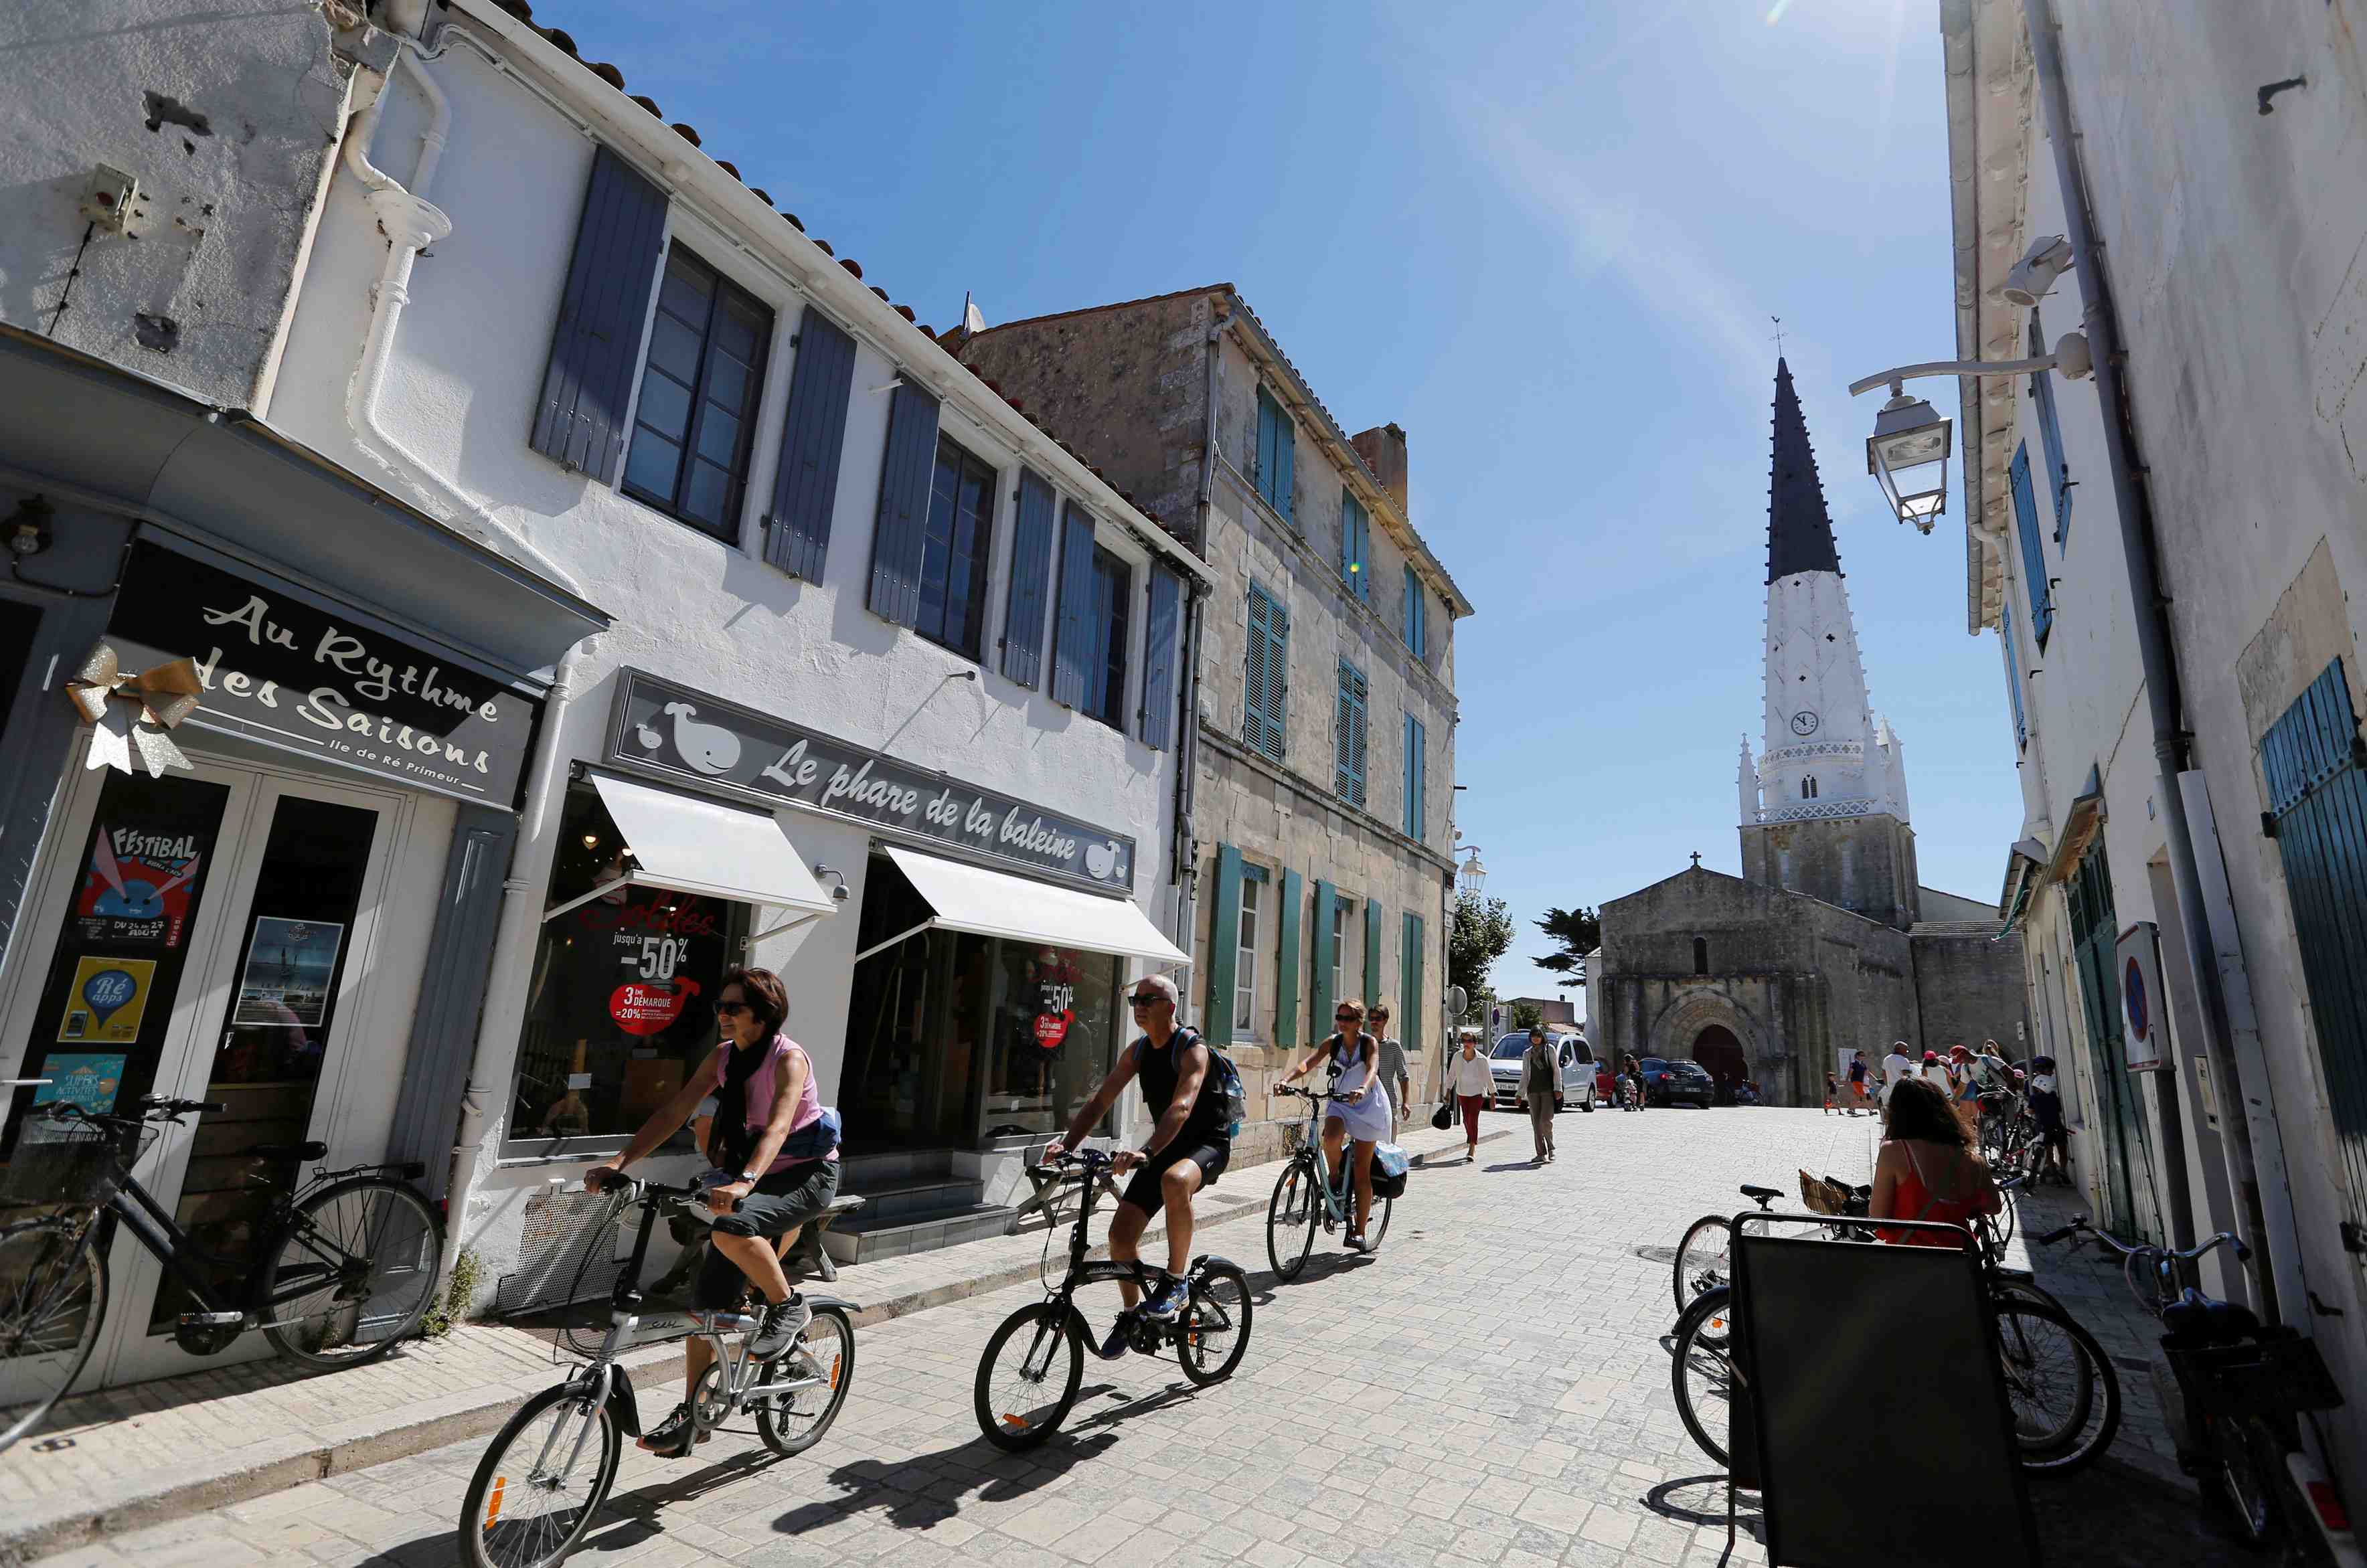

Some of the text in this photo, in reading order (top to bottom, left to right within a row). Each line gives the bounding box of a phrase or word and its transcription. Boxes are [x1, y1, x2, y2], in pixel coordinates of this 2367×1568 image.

[202, 595, 497, 723] Au Rythme
[296, 687, 489, 774] Saisons
[329, 739, 460, 784] Ile de Ré Primeur
[760, 739, 1076, 859] Le phare de la baleine
[621, 937, 688, 980] -50%
[92, 993, 123, 1003] apps
[96, 977, 127, 994] Ré
